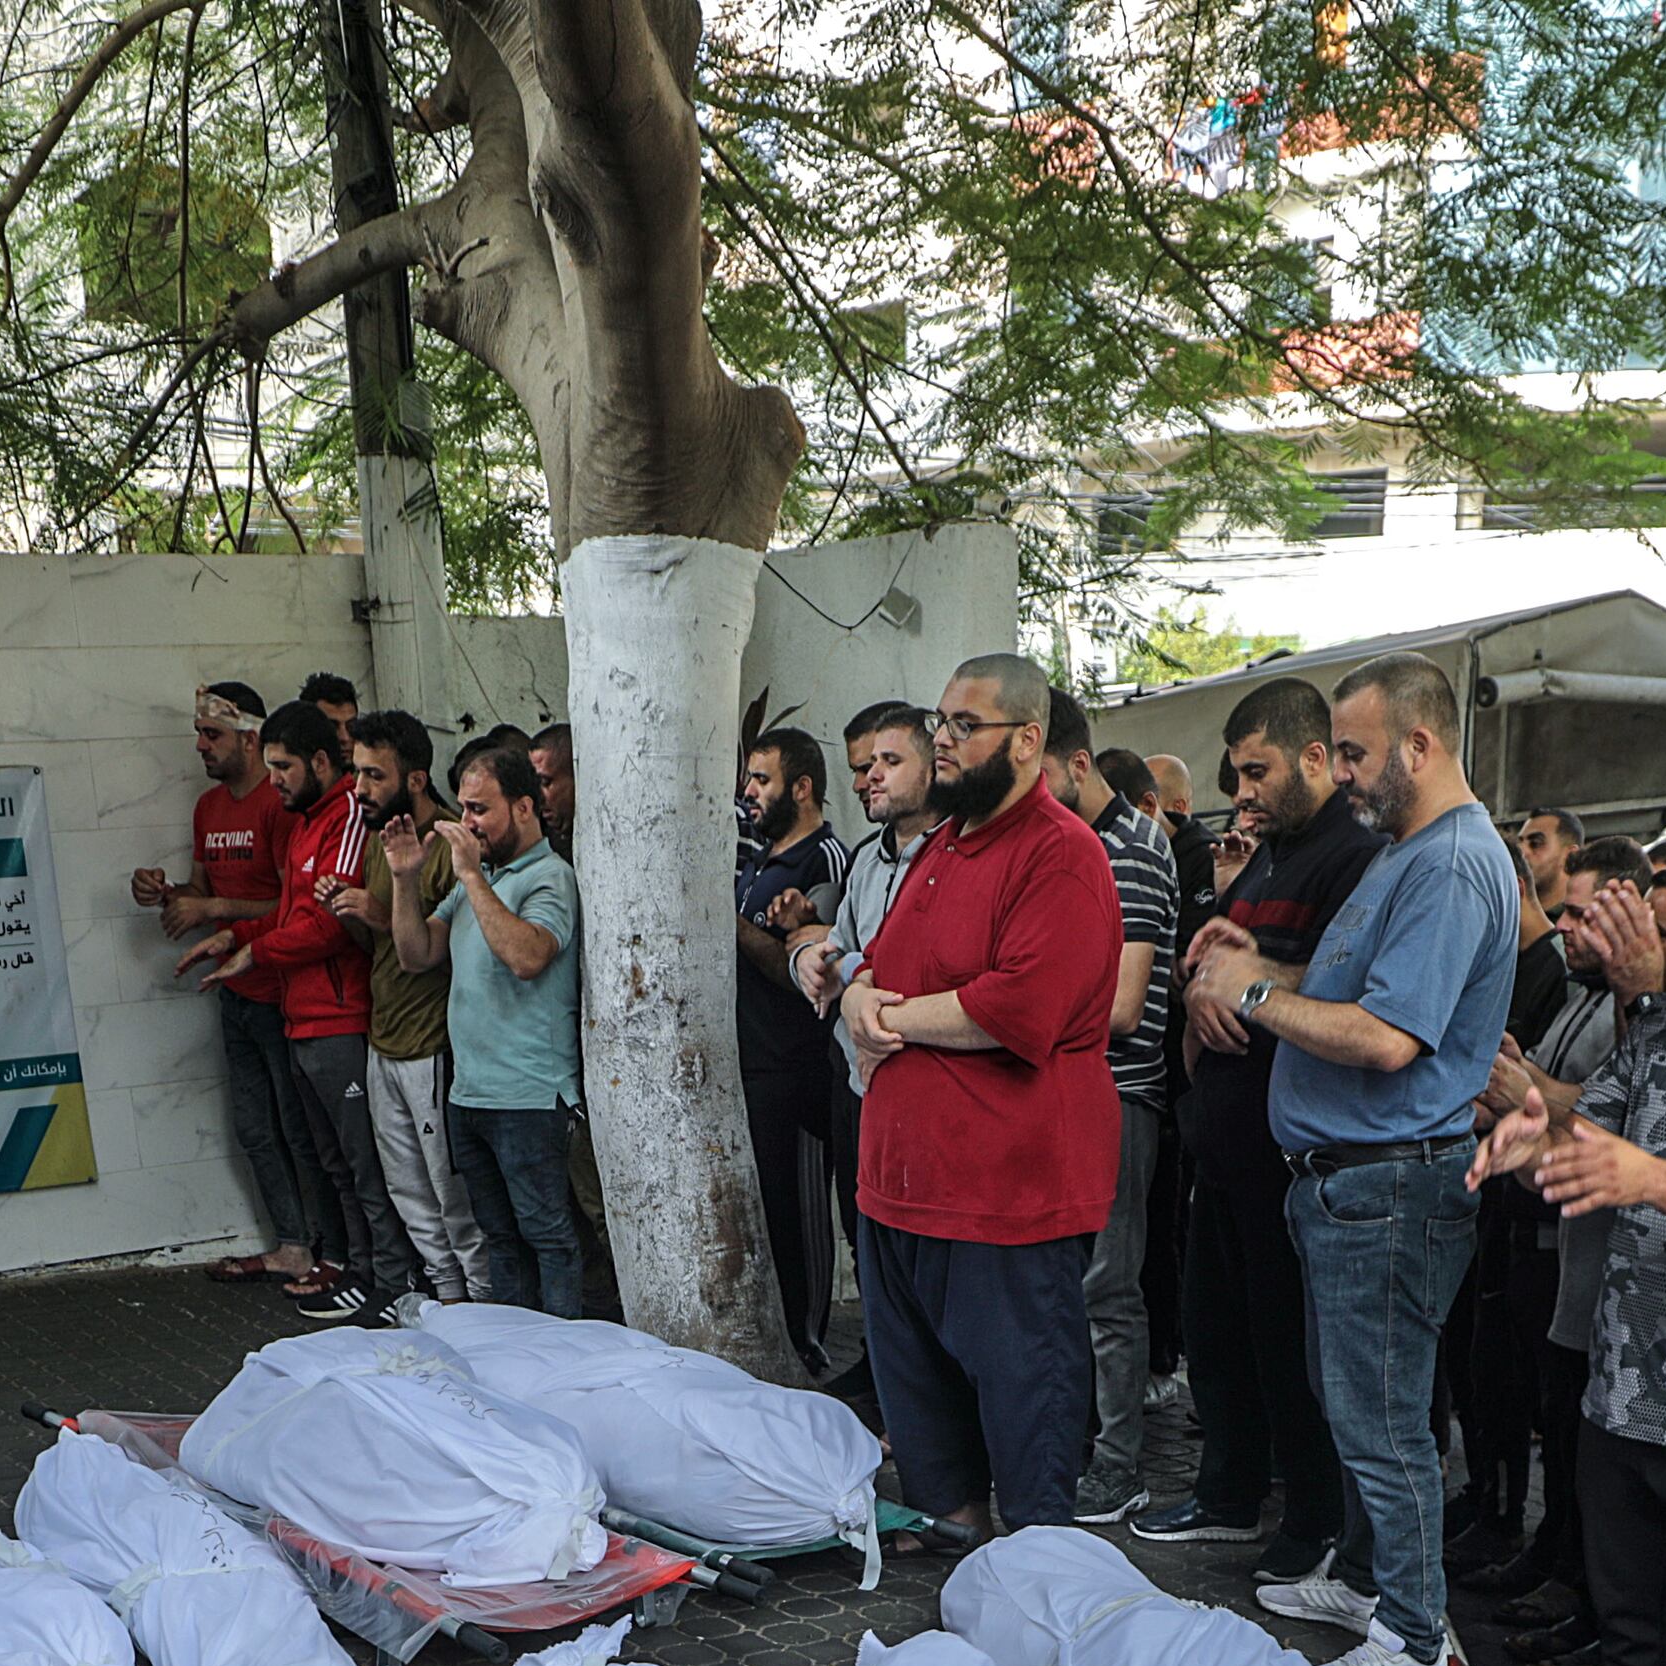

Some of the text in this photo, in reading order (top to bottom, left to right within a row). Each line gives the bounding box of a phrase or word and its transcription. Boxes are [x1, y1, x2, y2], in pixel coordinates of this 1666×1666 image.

[4, 890, 25, 913] أخي
[10, 951, 34, 969] قال
[3, 1063, 17, 1082] أن
[20, 1062, 67, 1078] بإمكانك
